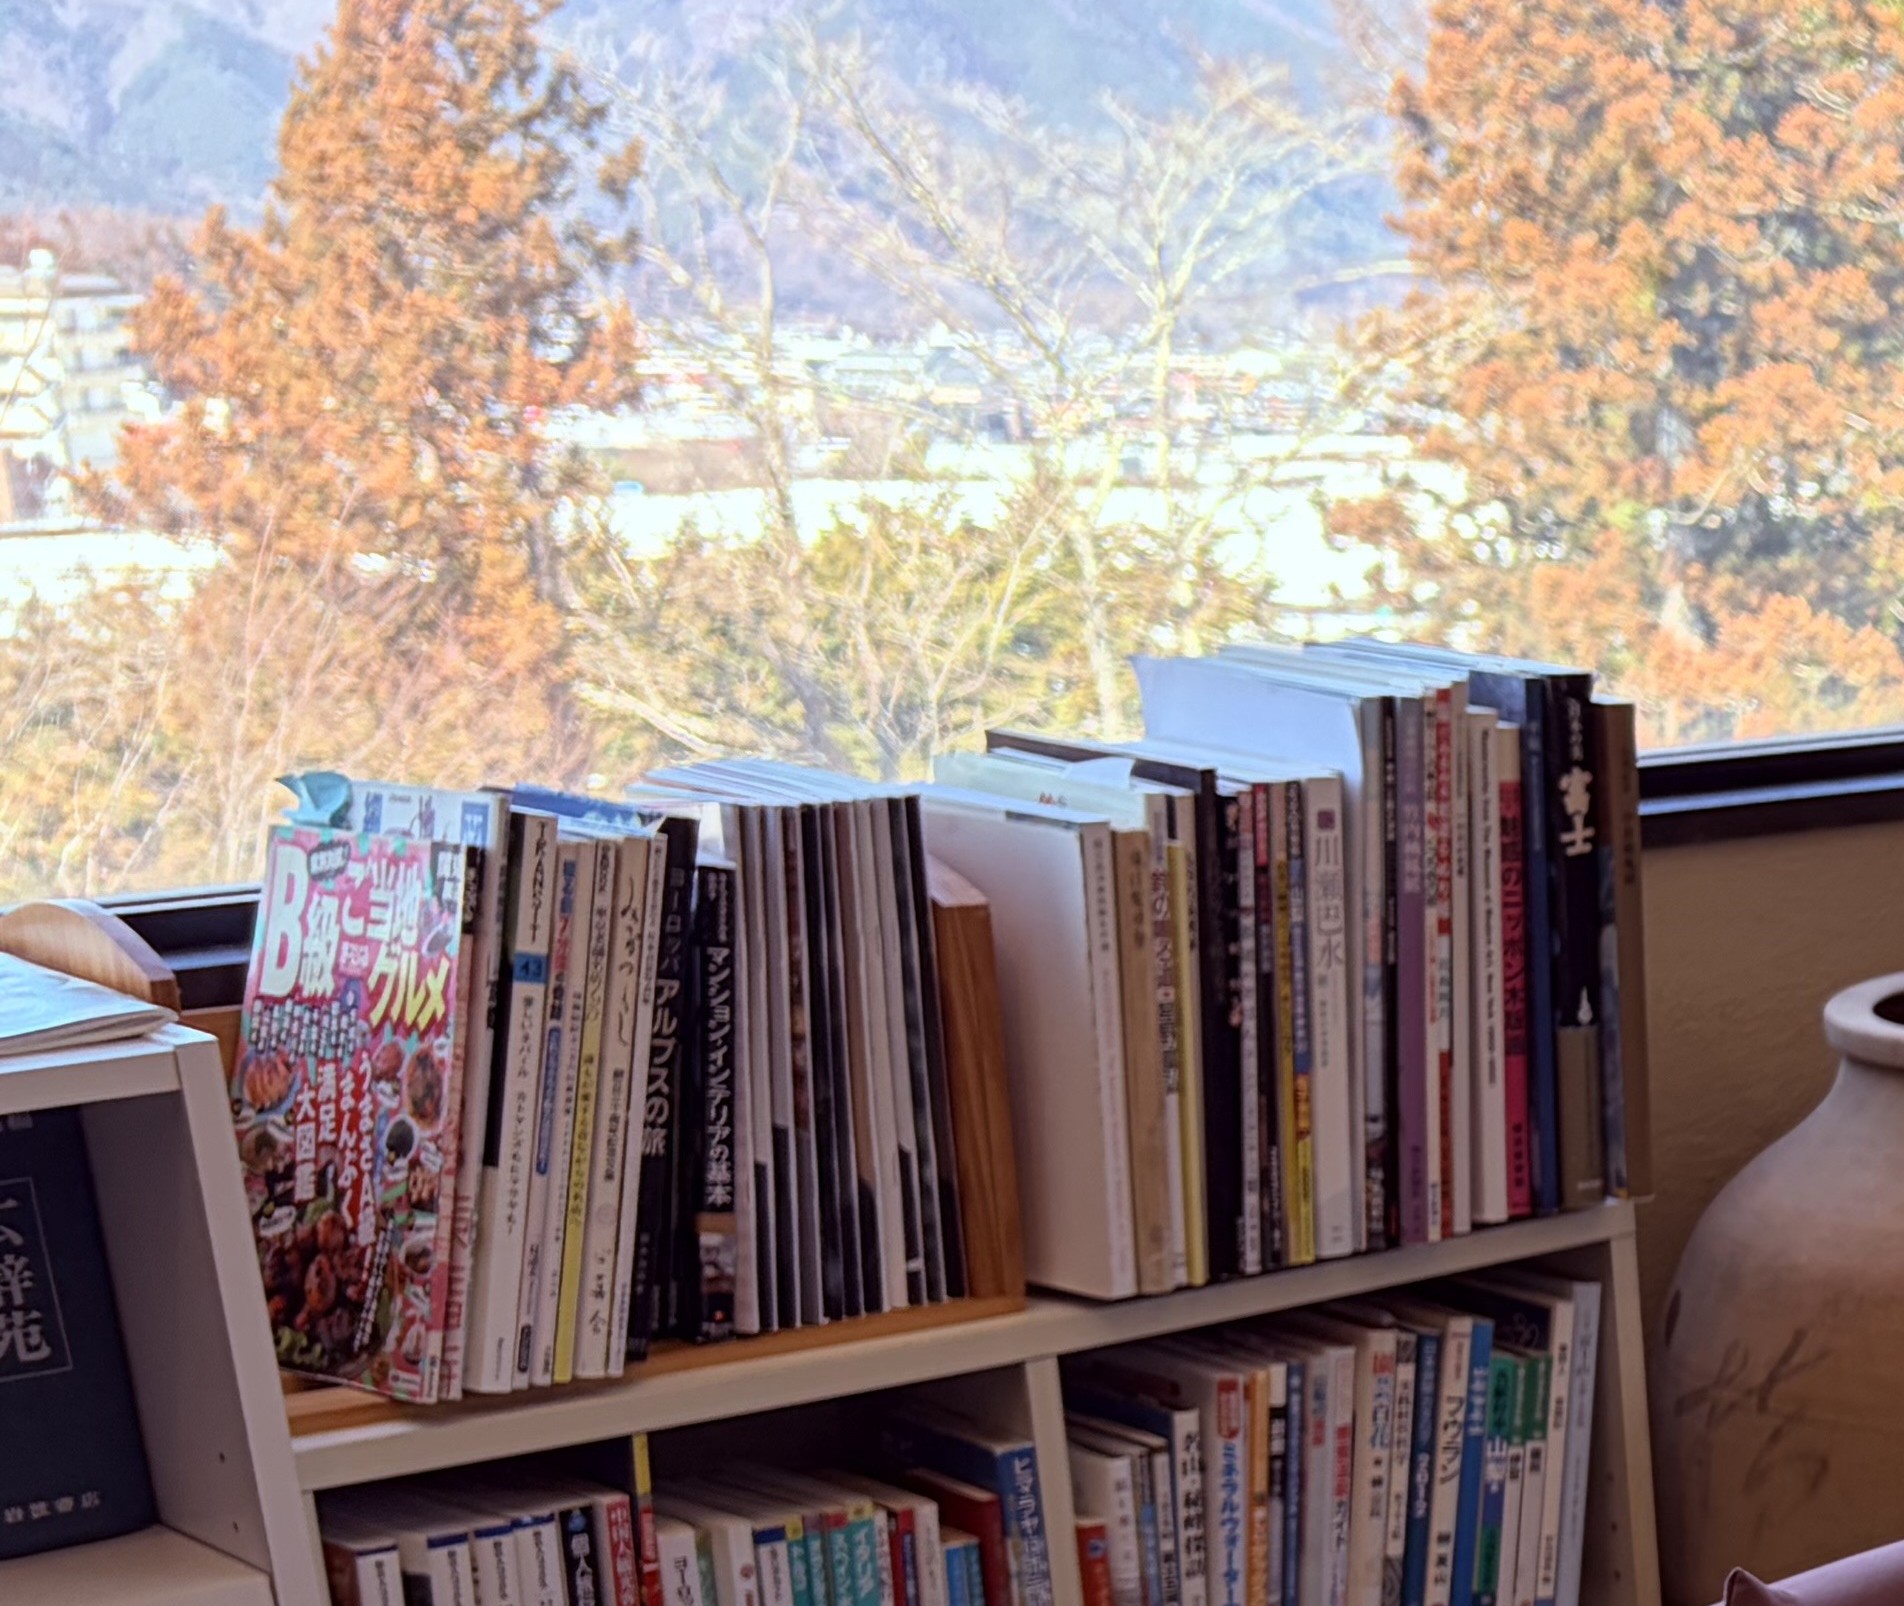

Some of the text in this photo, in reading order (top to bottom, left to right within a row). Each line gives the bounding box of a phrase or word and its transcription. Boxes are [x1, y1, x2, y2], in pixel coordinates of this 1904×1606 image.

[1558, 766, 1596, 857] 富士
[259, 843, 341, 1000] B級
[341, 852, 423, 948] ご当地
[528, 821, 547, 943] TRANSIT
[1314, 836, 1346, 970] 川瀬巴水
[368, 944, 451, 1032] グルメ
[641, 867, 685, 1156] ヨーロッパ アルプスの旅
[317, 1063, 337, 1142] 満足
[704, 946, 733, 1208] マンション・インテリアの基本
[337, 1070, 358, 1229] まんぷく
[3, 1490, 103, 1525] 岩波書店
